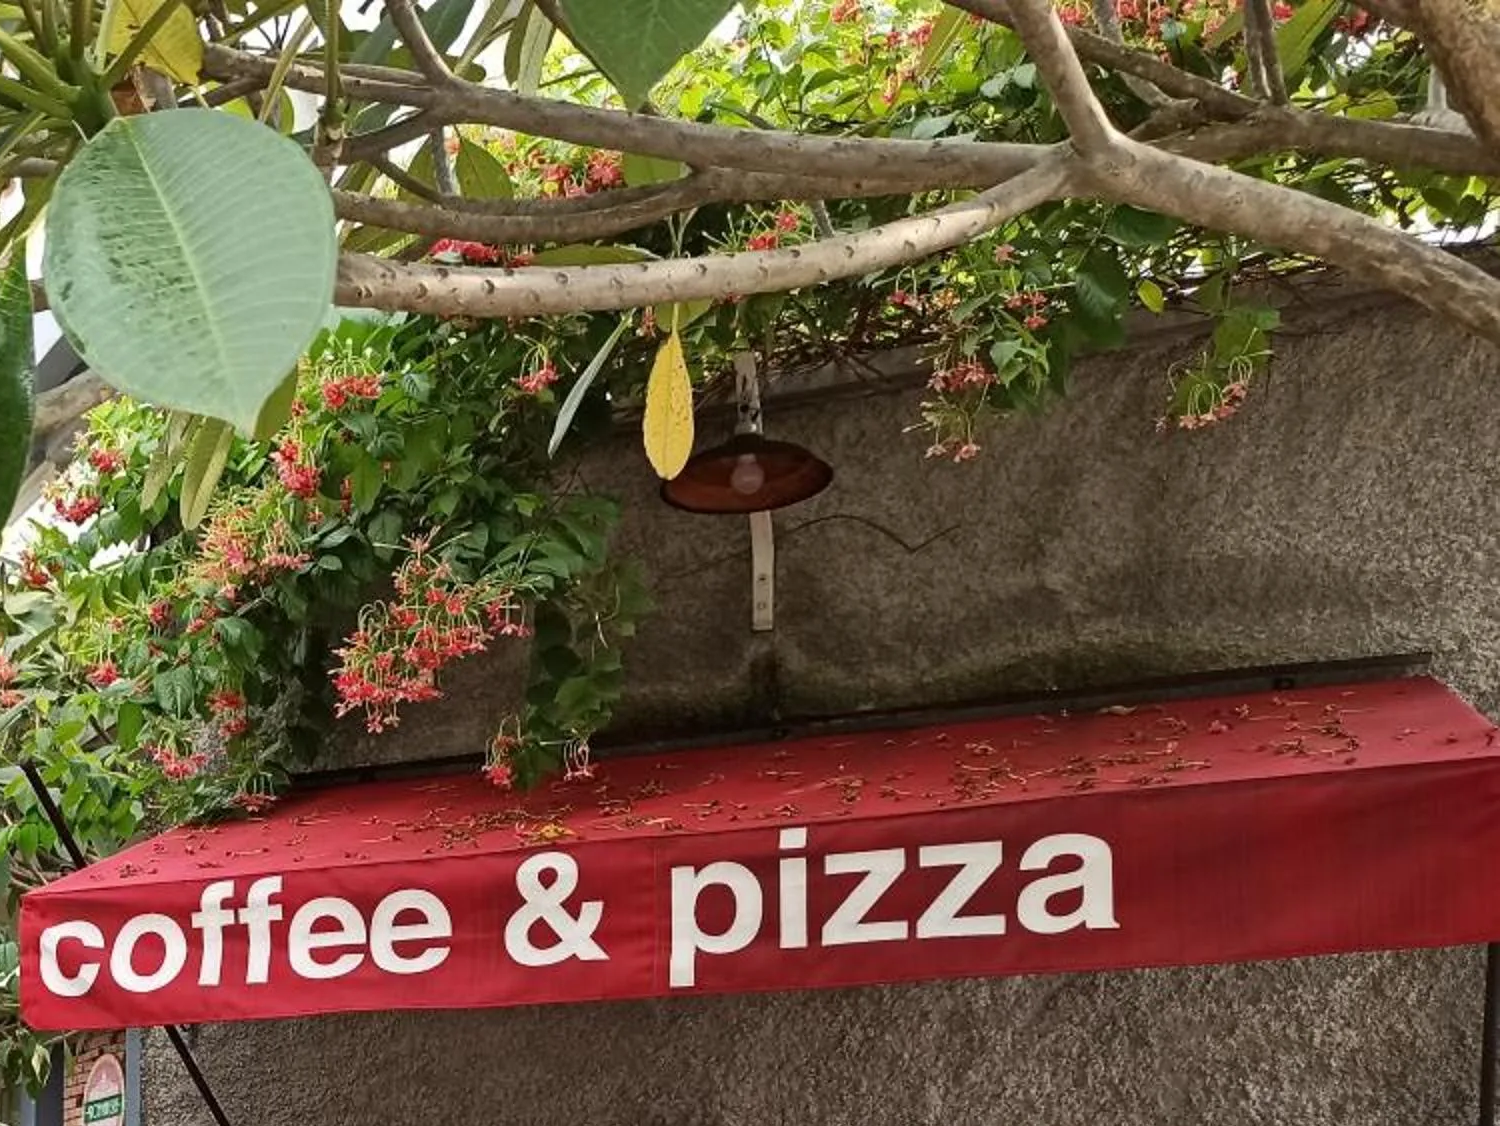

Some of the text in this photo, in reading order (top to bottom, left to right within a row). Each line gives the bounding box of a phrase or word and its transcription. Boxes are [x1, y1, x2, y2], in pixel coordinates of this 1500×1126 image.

[37, 827, 1119, 997] coffee & pizza
